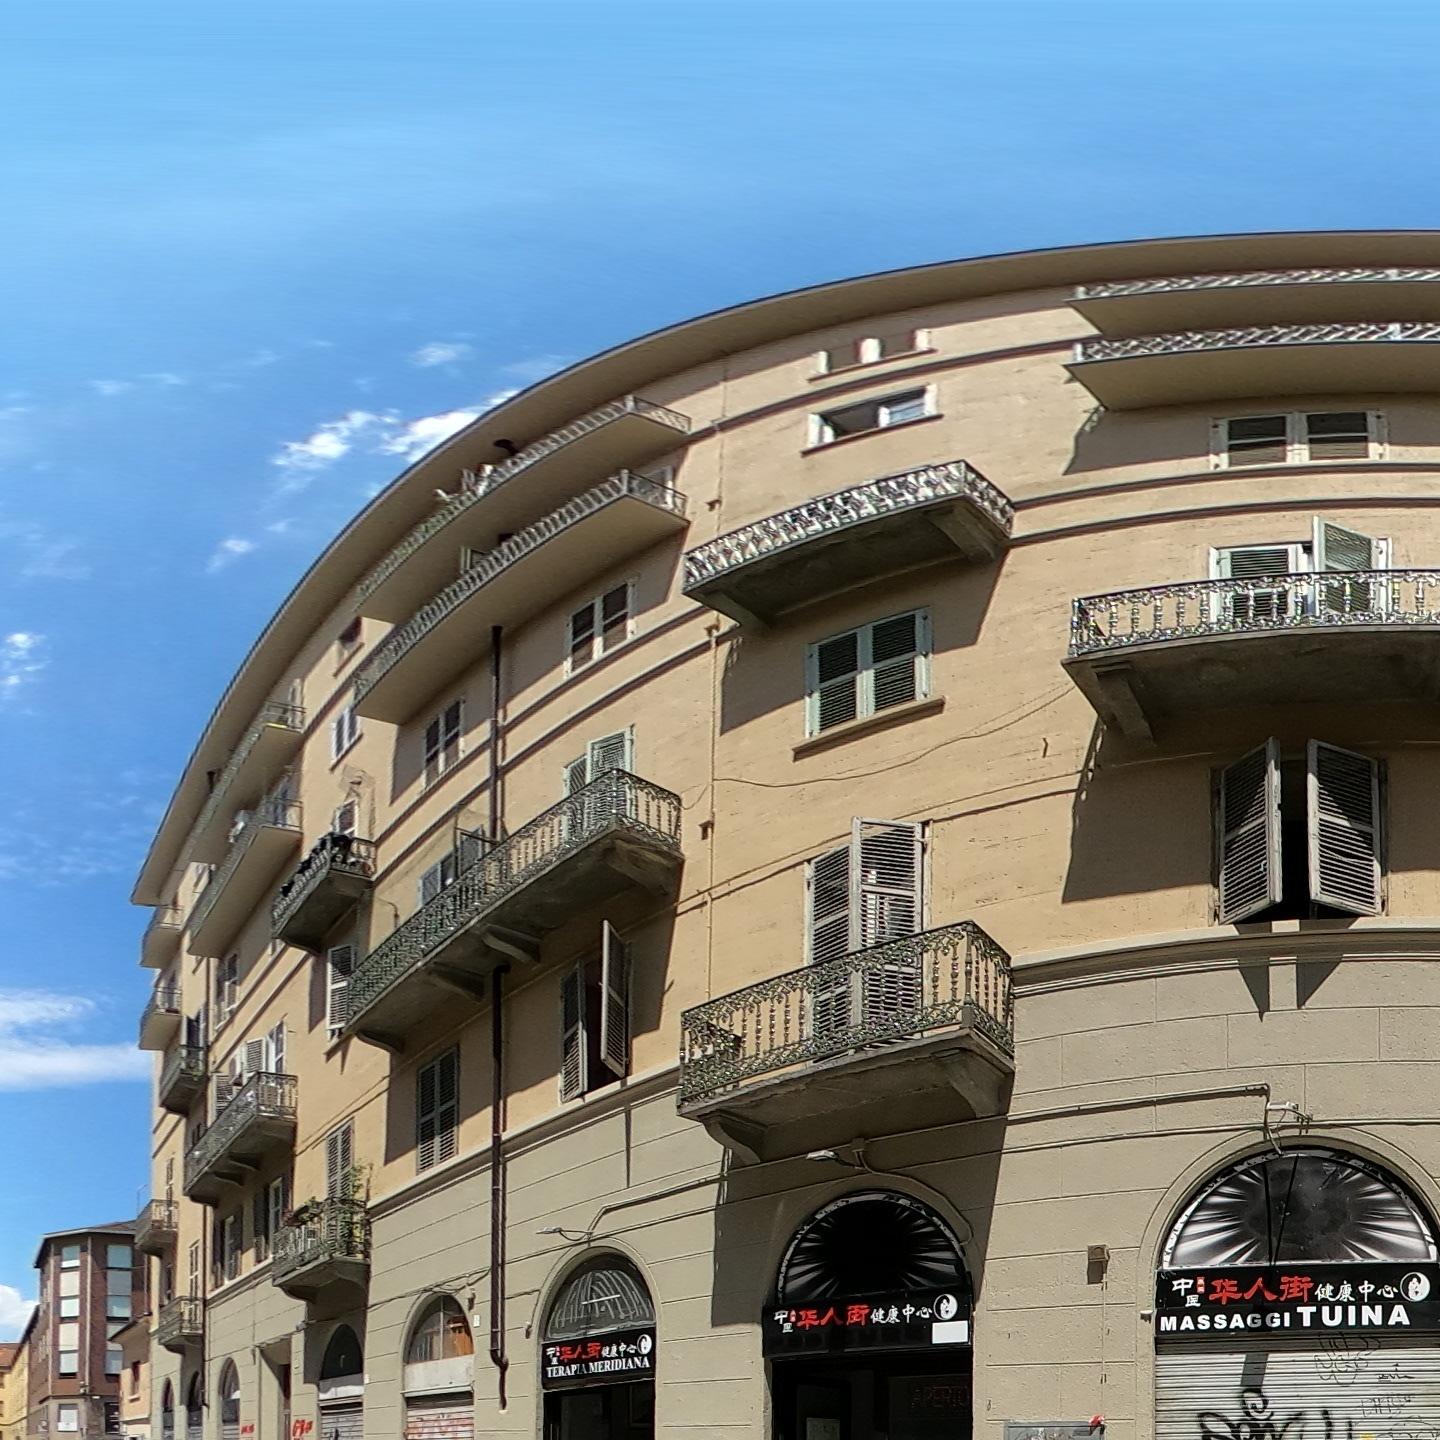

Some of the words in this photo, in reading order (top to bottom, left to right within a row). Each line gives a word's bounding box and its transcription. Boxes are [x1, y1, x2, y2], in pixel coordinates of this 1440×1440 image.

[1160, 1311, 1291, 1331] MASSAGGI
[1296, 1304, 1411, 1327] TUINA
[546, 1364, 588, 1377] TERAPIA
[589, 1356, 650, 1373] MERIDIANA
